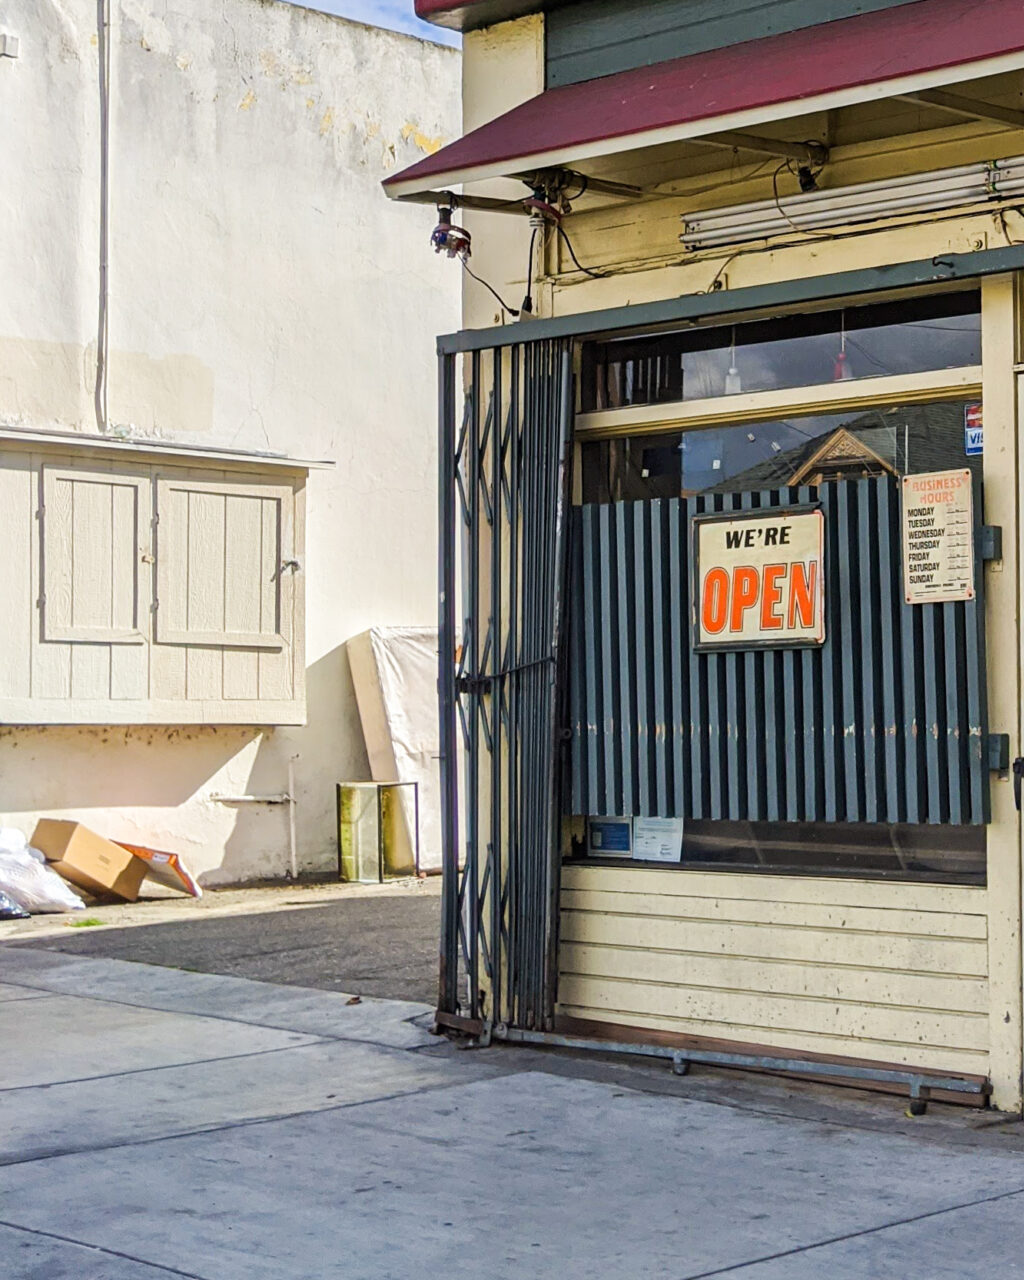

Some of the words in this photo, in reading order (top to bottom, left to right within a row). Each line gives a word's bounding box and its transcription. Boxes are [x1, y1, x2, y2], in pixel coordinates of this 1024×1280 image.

[970, 432, 984, 445] VI
[907, 507, 934, 518] MONDAY
[908, 518, 935, 529] TUESDAY
[725, 525, 793, 550] WE'RE
[908, 528, 946, 540] WEDNESDAY
[908, 540, 941, 551] THURSDAY
[908, 552, 930, 562] FRIDAY
[908, 562, 941, 573] SATURDAY
[909, 573, 935, 584] SUNDAY
[701, 560, 819, 636] OPEN
